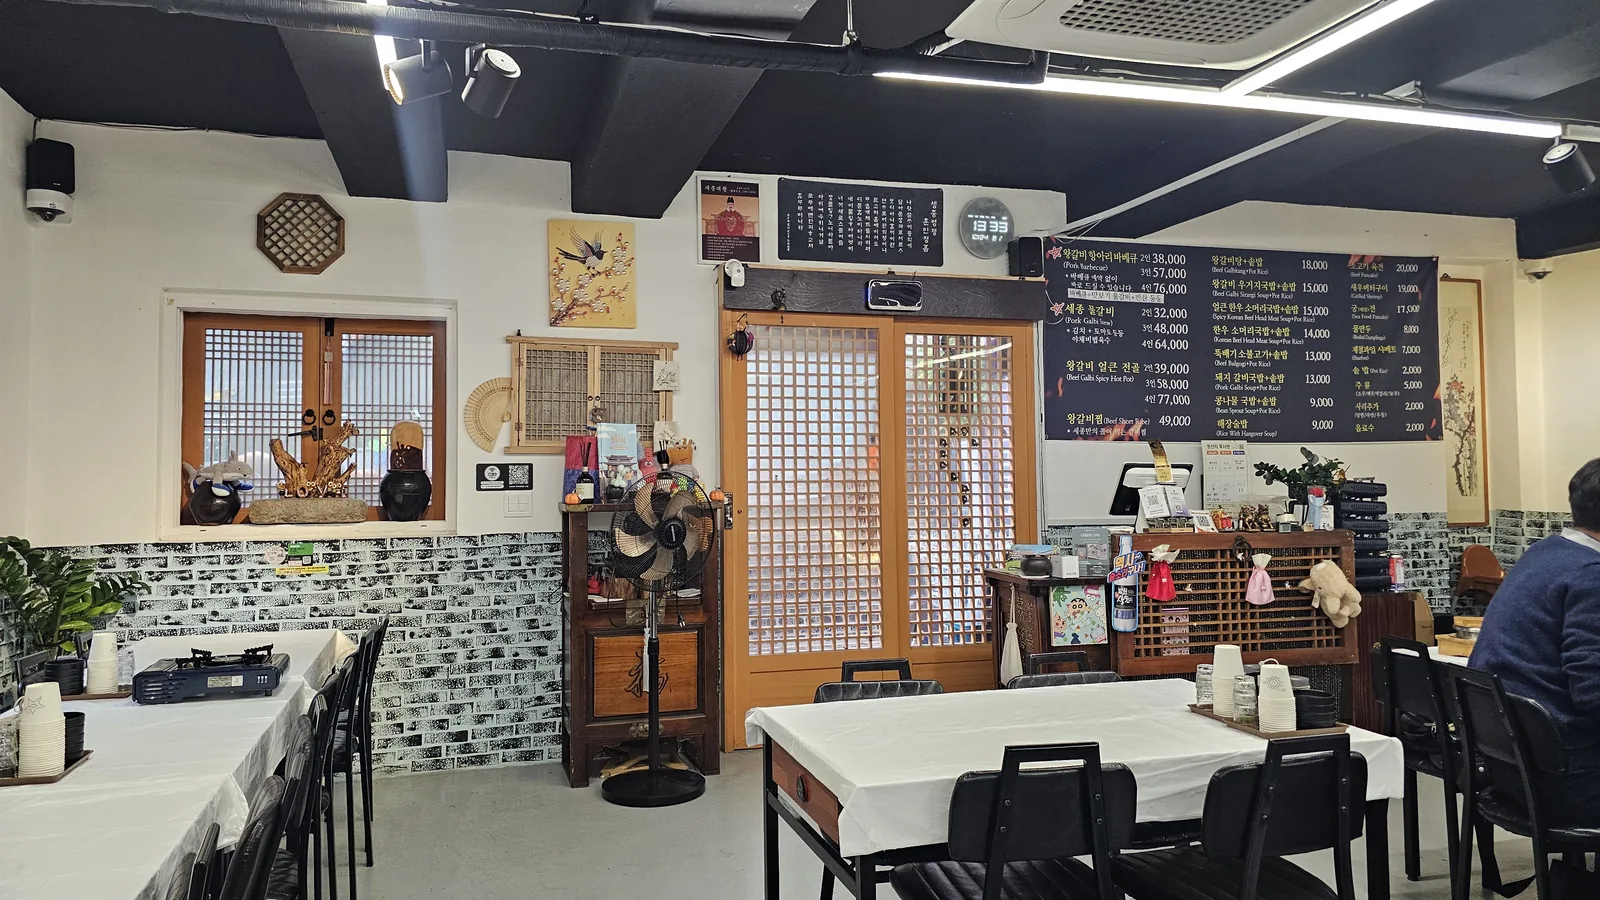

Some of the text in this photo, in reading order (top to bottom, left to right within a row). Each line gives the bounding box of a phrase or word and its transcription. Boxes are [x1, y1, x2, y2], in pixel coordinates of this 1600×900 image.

[1153, 253, 1186, 265] 38,000
[1211, 255, 1328, 270] 왕갈비탕+솥밥 18,000
[1153, 268, 1186, 279] 57,000
[1396, 264, 1418, 272] 20,000
[1104, 275, 1118, 283] 없이
[1153, 283, 1187, 294] 76,000
[1212, 279, 1328, 293] 왕갈비 우거지국밥+솥밥 15,000
[1398, 285, 1418, 293] 19,000
[1065, 304, 1084, 314] 세종
[1142, 309, 1152, 317] 2인
[1154, 308, 1187, 319] 32,000
[1212, 302, 1328, 316] 얼큰 한우 소머리국밥+솥밥 15,000
[1065, 317, 1081, 325] (Pork
[1154, 324, 1188, 334] 48,000
[1213, 325, 1330, 338] 한우 소머리국밥+솥밥 14,000
[1142, 339, 1188, 350] 4인 64,000
[1402, 346, 1421, 354] 7,000
[1305, 351, 1331, 361] 13,000
[1066, 360, 1189, 374] 왕갈비 얼큰 전골 2인 39,000
[1402, 366, 1422, 375] 2,000
[1081, 374, 1094, 382] Galbi
[1096, 375, 1109, 383] Spicy
[1215, 373, 1330, 384] 돼지 갈비국밥+솥밥 13,000
[1157, 379, 1188, 390] 58,000
[1404, 381, 1422, 390] 5,000
[1145, 394, 1190, 405] 4인 77,000
[1214, 396, 1333, 408] 콩나물 국밥+솥밥 9,000
[1405, 402, 1424, 410] 2,000
[1067, 413, 1102, 425] 왕갈비찜
[1104, 417, 1117, 425] (Beef
[1159, 415, 1190, 427] 49,000
[1217, 419, 1333, 430] 해장술밥 9,000
[1355, 423, 1424, 433] 음료수 2,000
